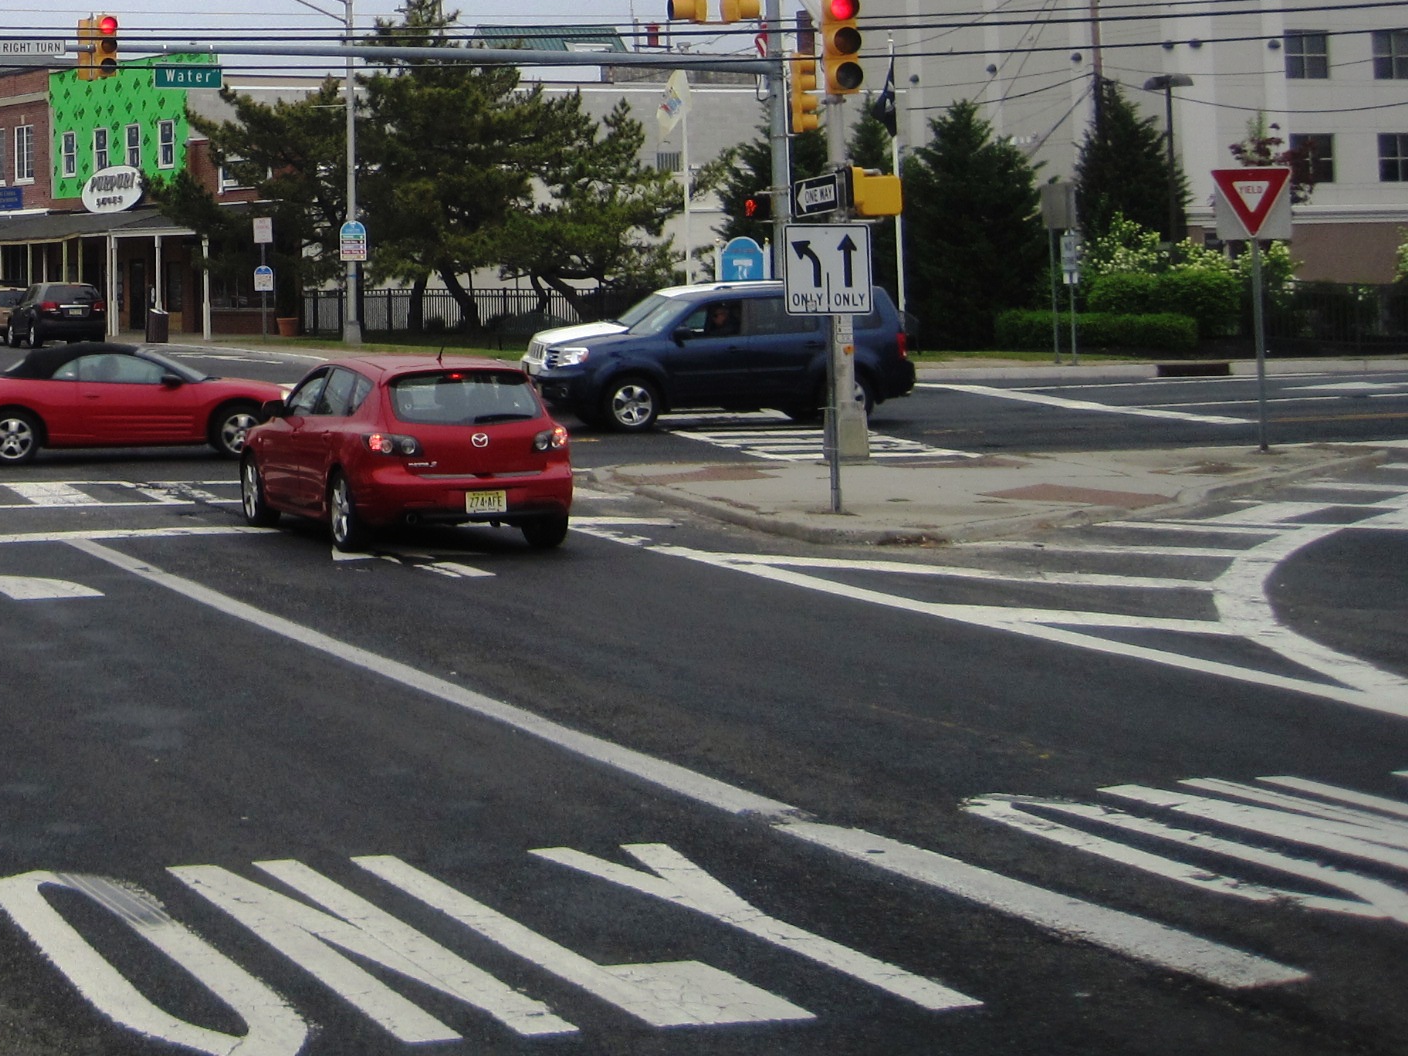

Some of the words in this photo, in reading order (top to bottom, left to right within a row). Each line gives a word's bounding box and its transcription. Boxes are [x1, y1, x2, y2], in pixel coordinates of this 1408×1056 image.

[2, 42, 32, 53] RIGHT
[35, 42, 61, 53] TURN
[165, 69, 211, 83] Water
[804, 188, 818, 204] ONE
[819, 185, 833, 201] WAY
[1239, 185, 1263, 194] YIELD
[834, 293, 865, 307] ONLY
